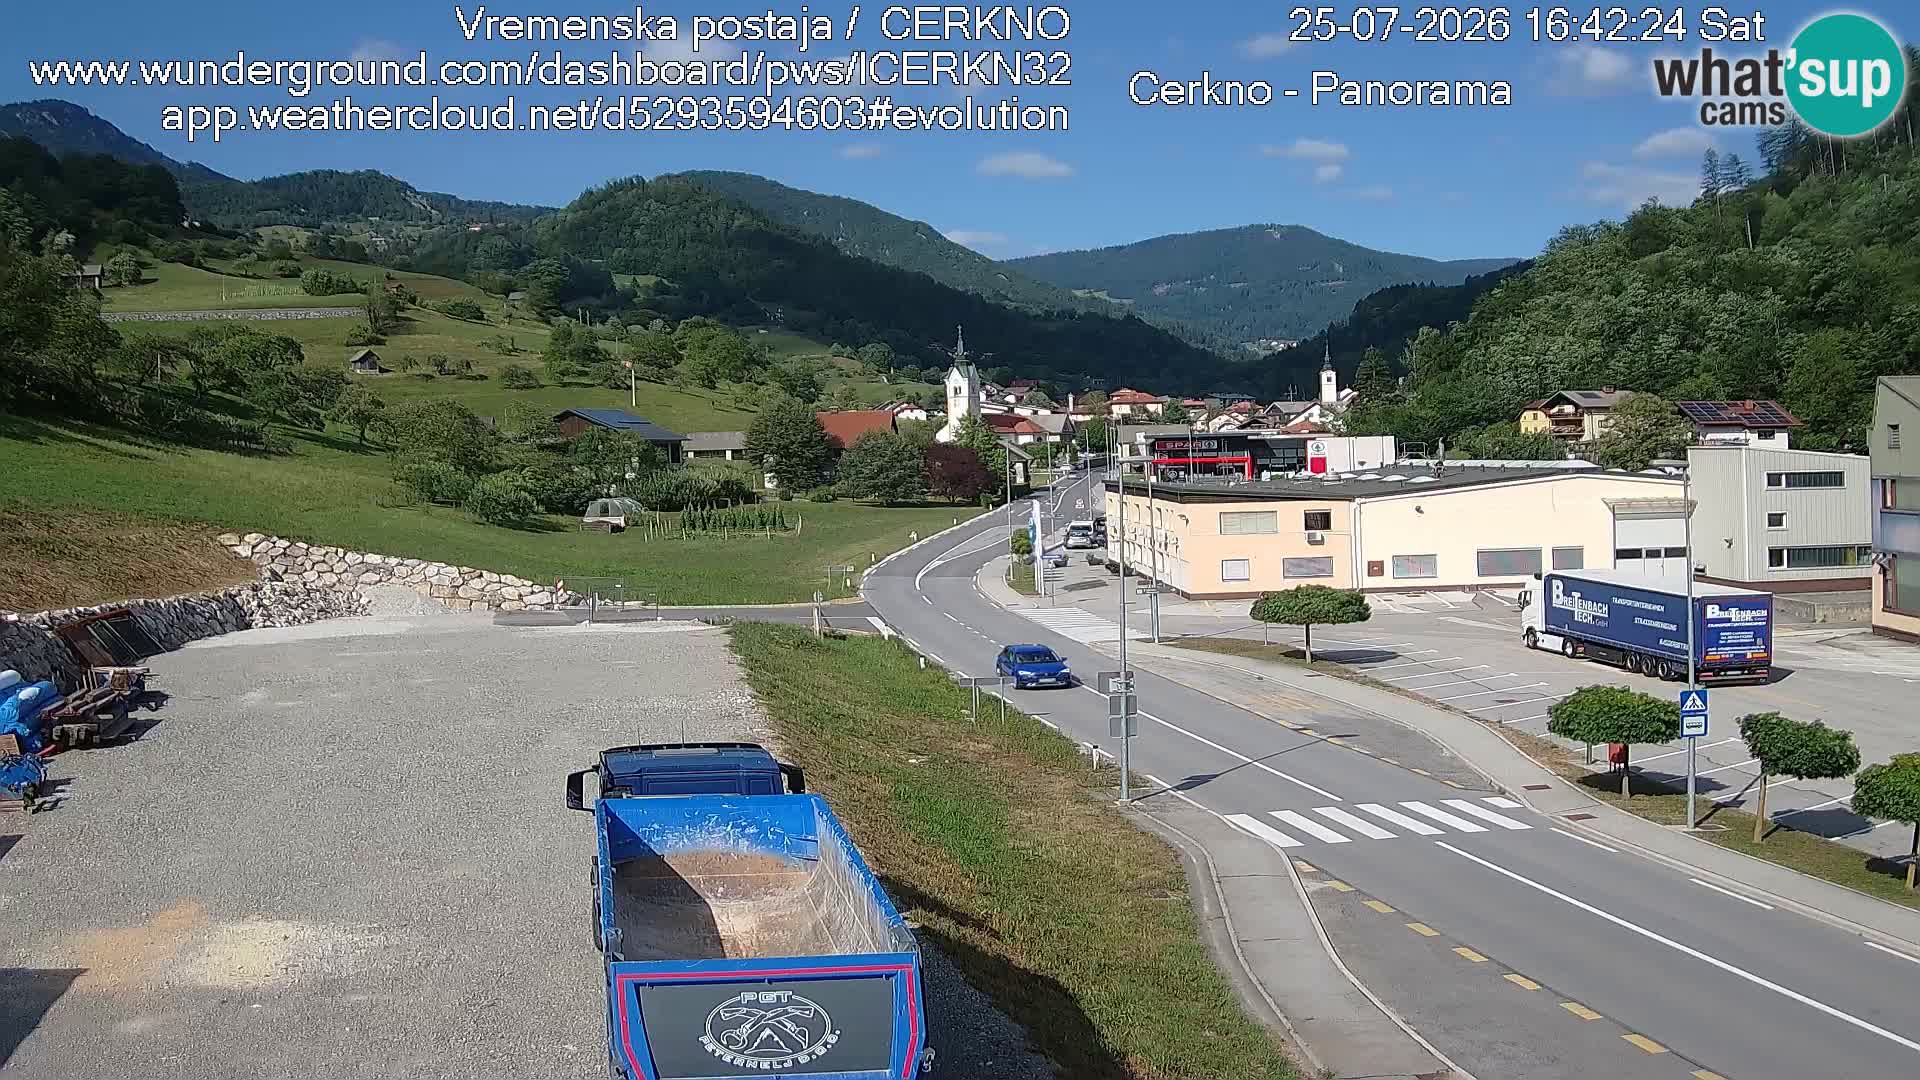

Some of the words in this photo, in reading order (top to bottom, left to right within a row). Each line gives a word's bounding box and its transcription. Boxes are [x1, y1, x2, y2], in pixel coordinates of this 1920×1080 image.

[1166, 440, 1202, 449] SPAR
[740, 990, 793, 1004] PGT
[699, 1035, 793, 1069] PETERNELJ
